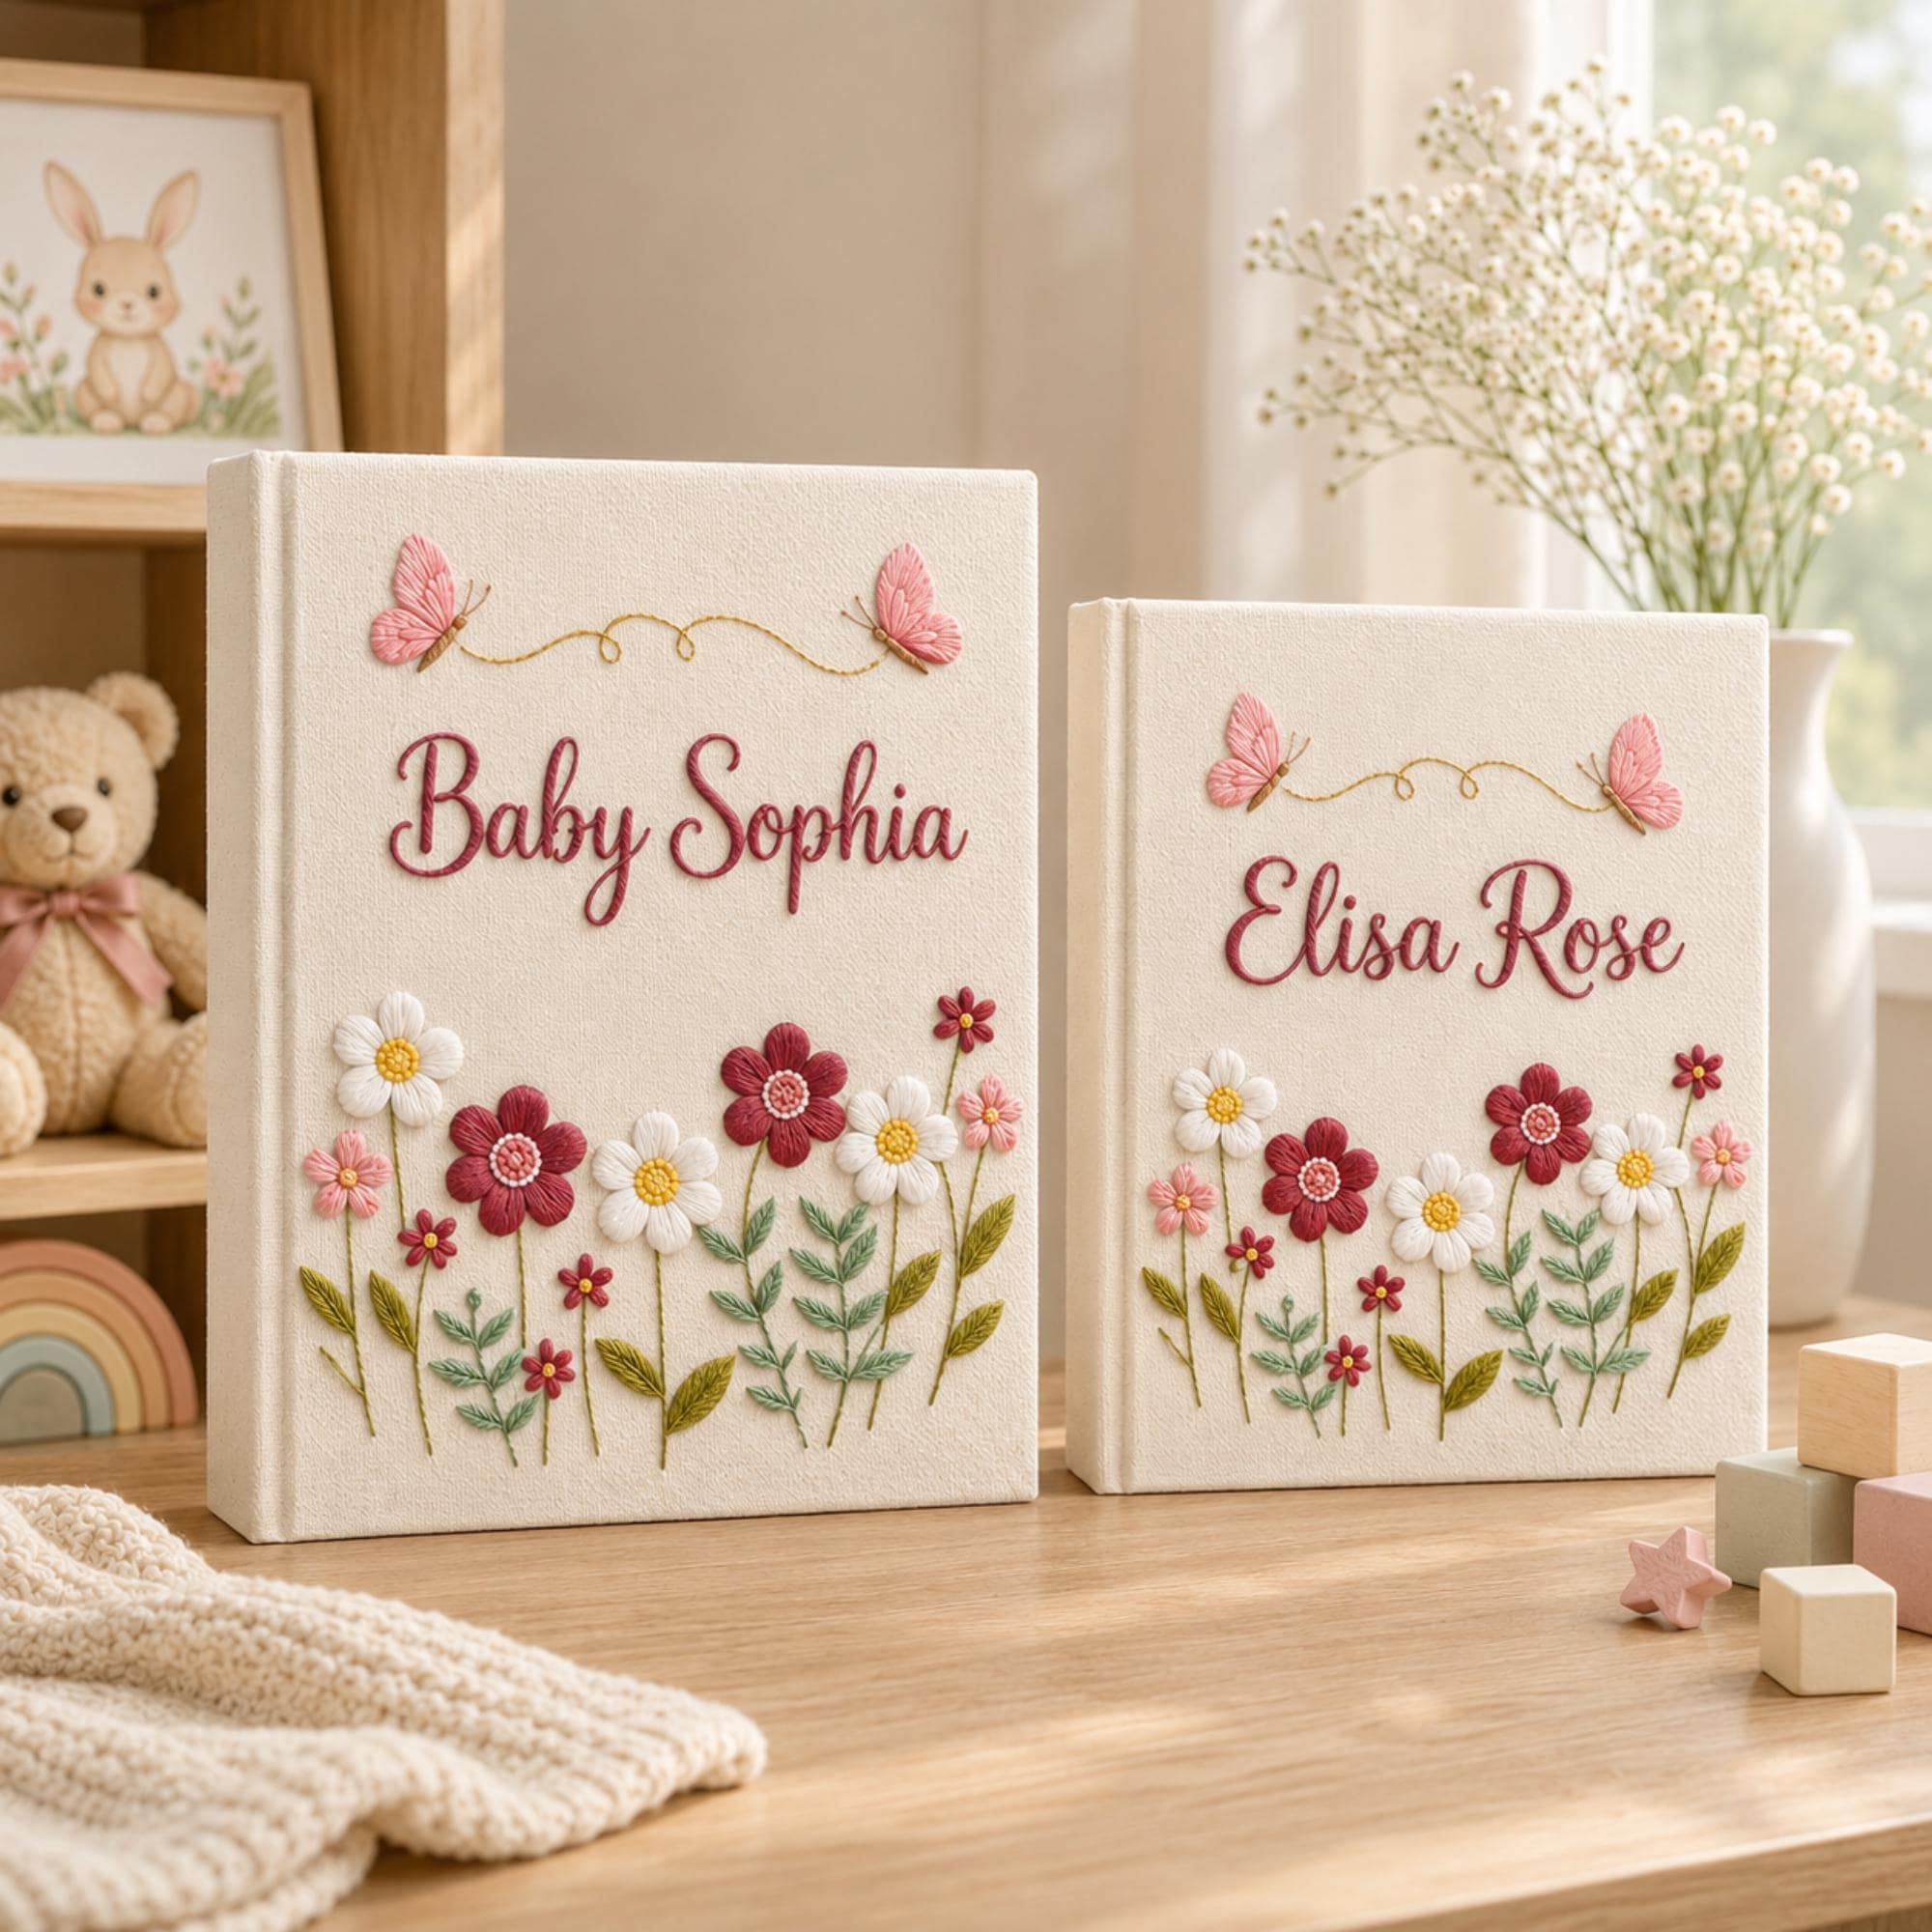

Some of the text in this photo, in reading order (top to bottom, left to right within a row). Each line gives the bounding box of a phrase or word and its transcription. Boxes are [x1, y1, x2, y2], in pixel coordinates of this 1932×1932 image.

[389, 732, 969, 927] Baby Sophia
[1224, 855, 1686, 1001] Elisa Rose
